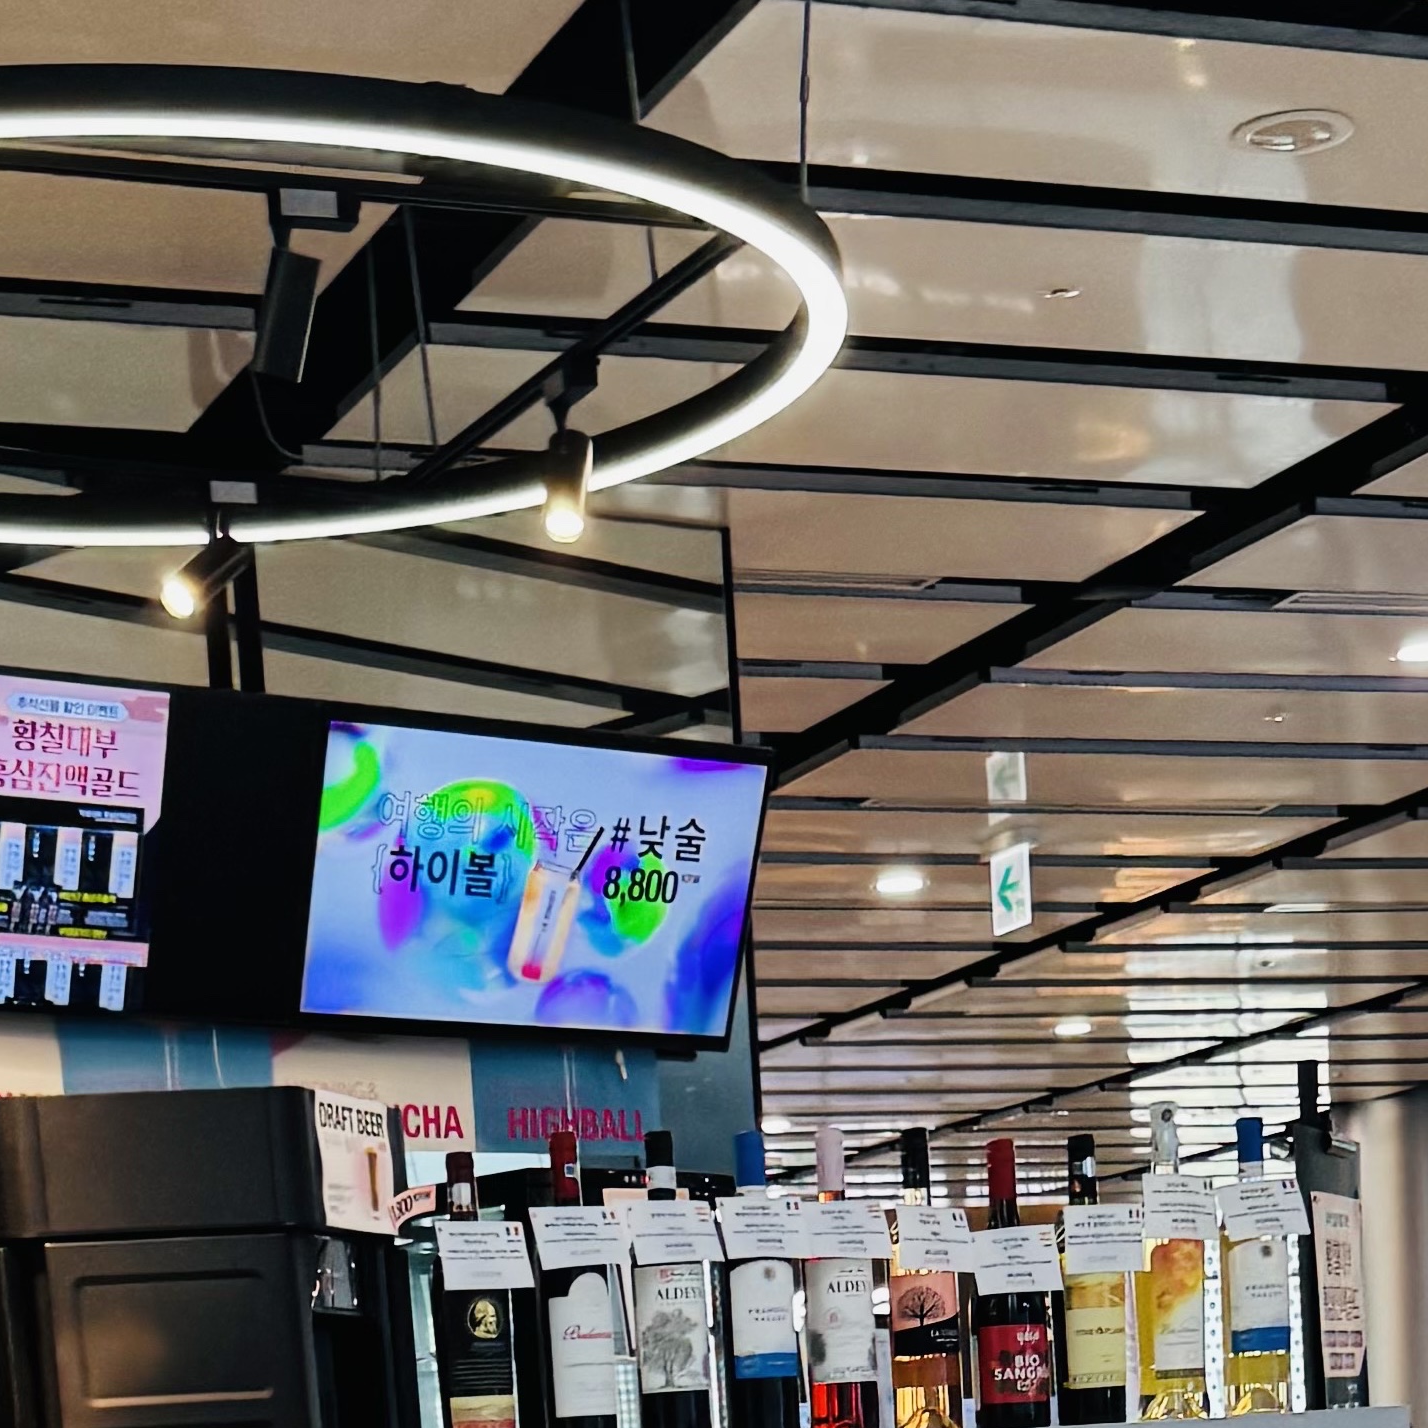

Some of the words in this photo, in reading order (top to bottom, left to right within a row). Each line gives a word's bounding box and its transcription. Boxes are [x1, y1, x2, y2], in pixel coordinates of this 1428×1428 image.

[12, 719, 119, 760] 황칠대부
[378, 790, 484, 845] 여행의
[499, 802, 599, 858] 시작은
[602, 865, 680, 908] 8,800
[318, 1101, 355, 1134] DRAFT
[356, 1108, 386, 1139] BEER
[506, 1106, 645, 1143] HIGHBALL
